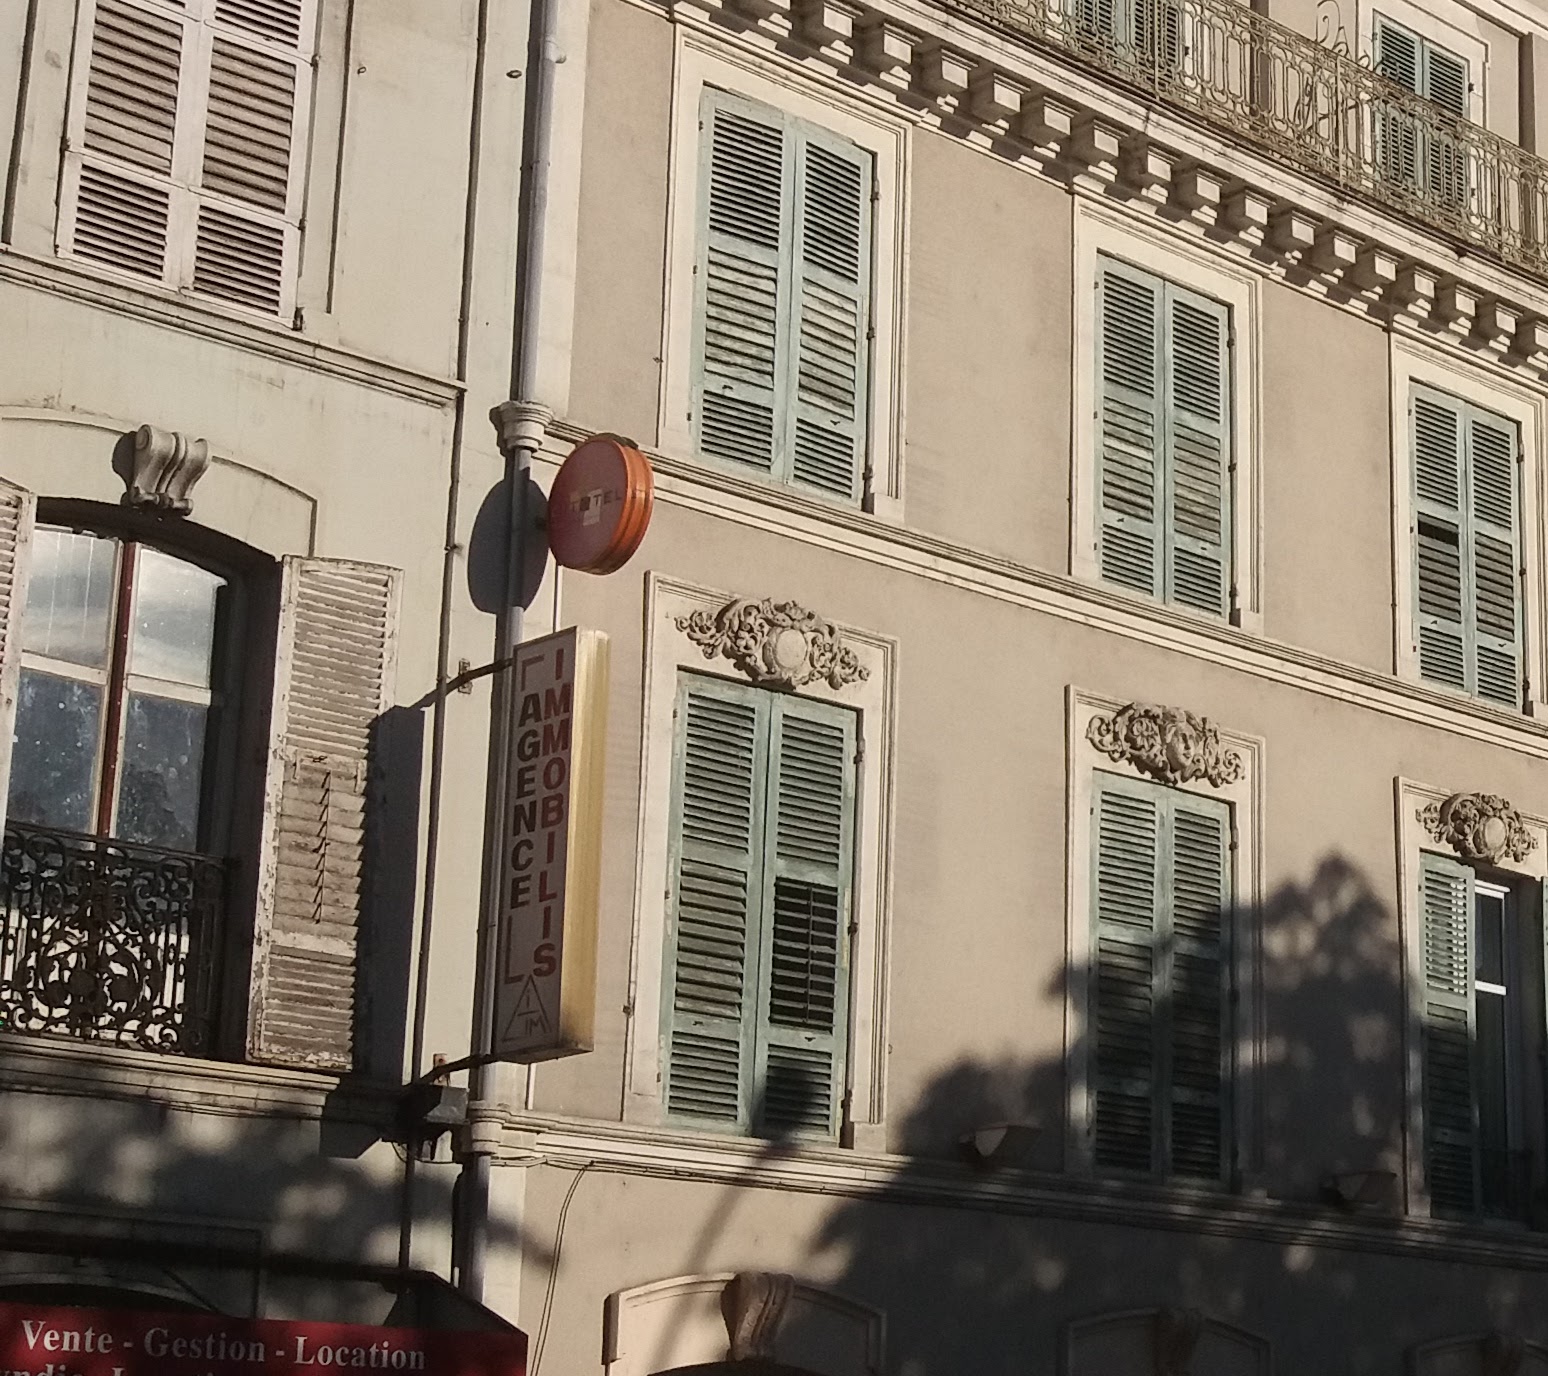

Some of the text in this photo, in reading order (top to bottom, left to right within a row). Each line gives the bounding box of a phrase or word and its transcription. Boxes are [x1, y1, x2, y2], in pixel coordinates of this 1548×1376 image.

[510, 693, 542, 910] AGENCE
[533, 648, 571, 977] IMMOBILIS
[21, 1319, 113, 1354] Vente
[144, 1327, 265, 1363] Gestion
[294, 1335, 427, 1370] Location
